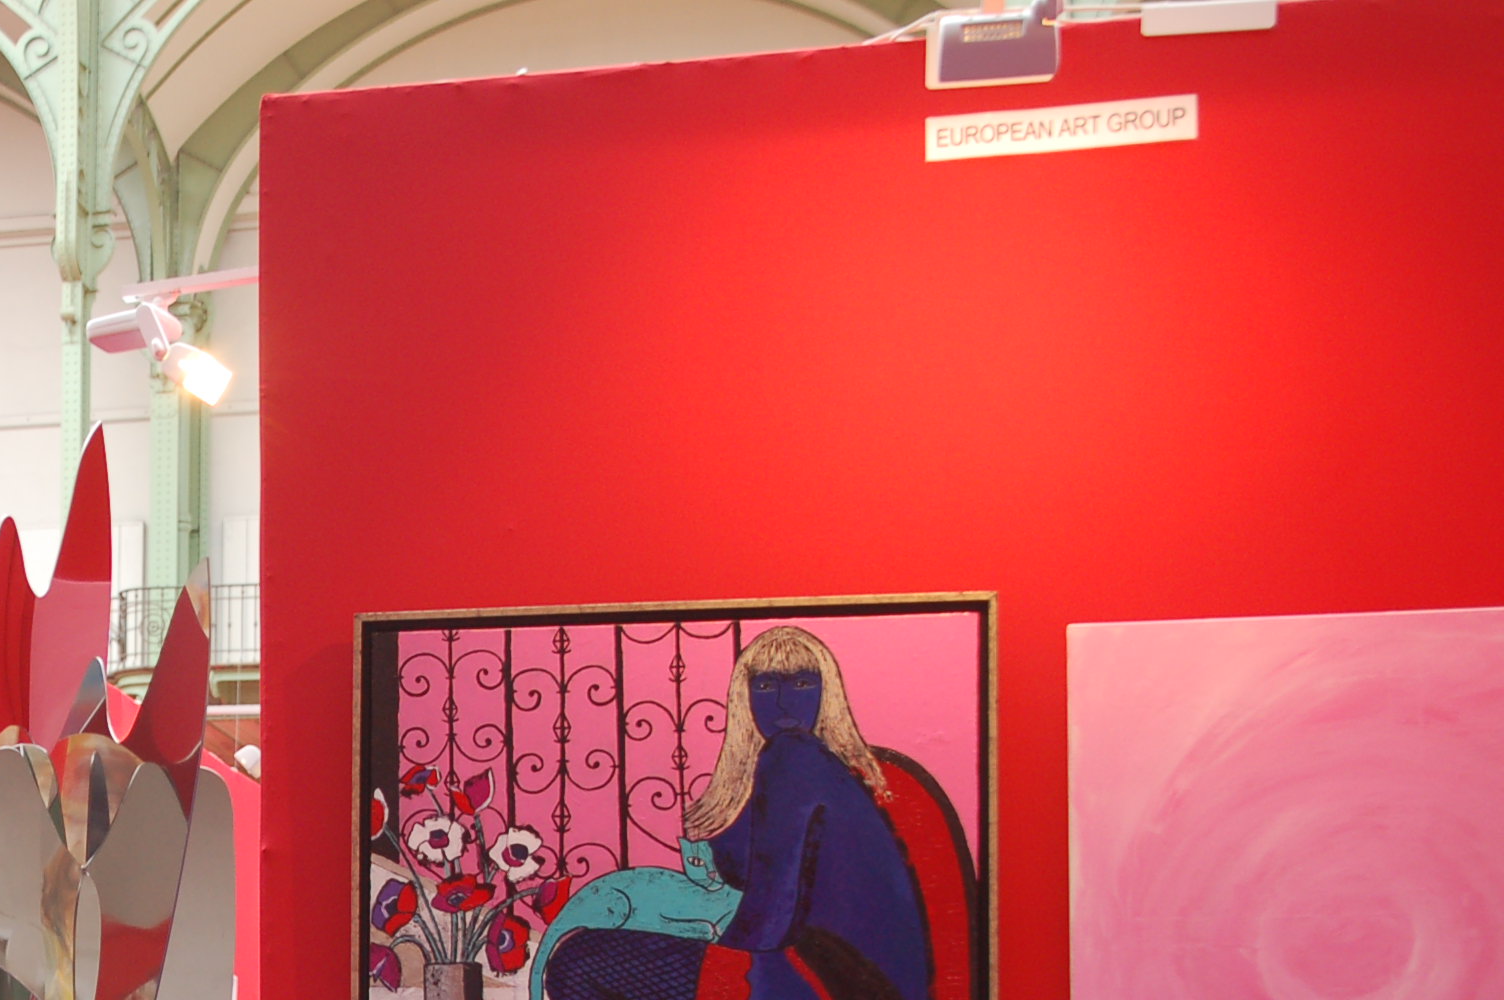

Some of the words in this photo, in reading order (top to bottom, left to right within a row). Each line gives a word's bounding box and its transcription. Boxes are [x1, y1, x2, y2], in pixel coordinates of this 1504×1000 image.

[936, 120, 1053, 148] EUROPEAN
[1058, 114, 1101, 138] ART
[1107, 107, 1187, 133] GROUP
